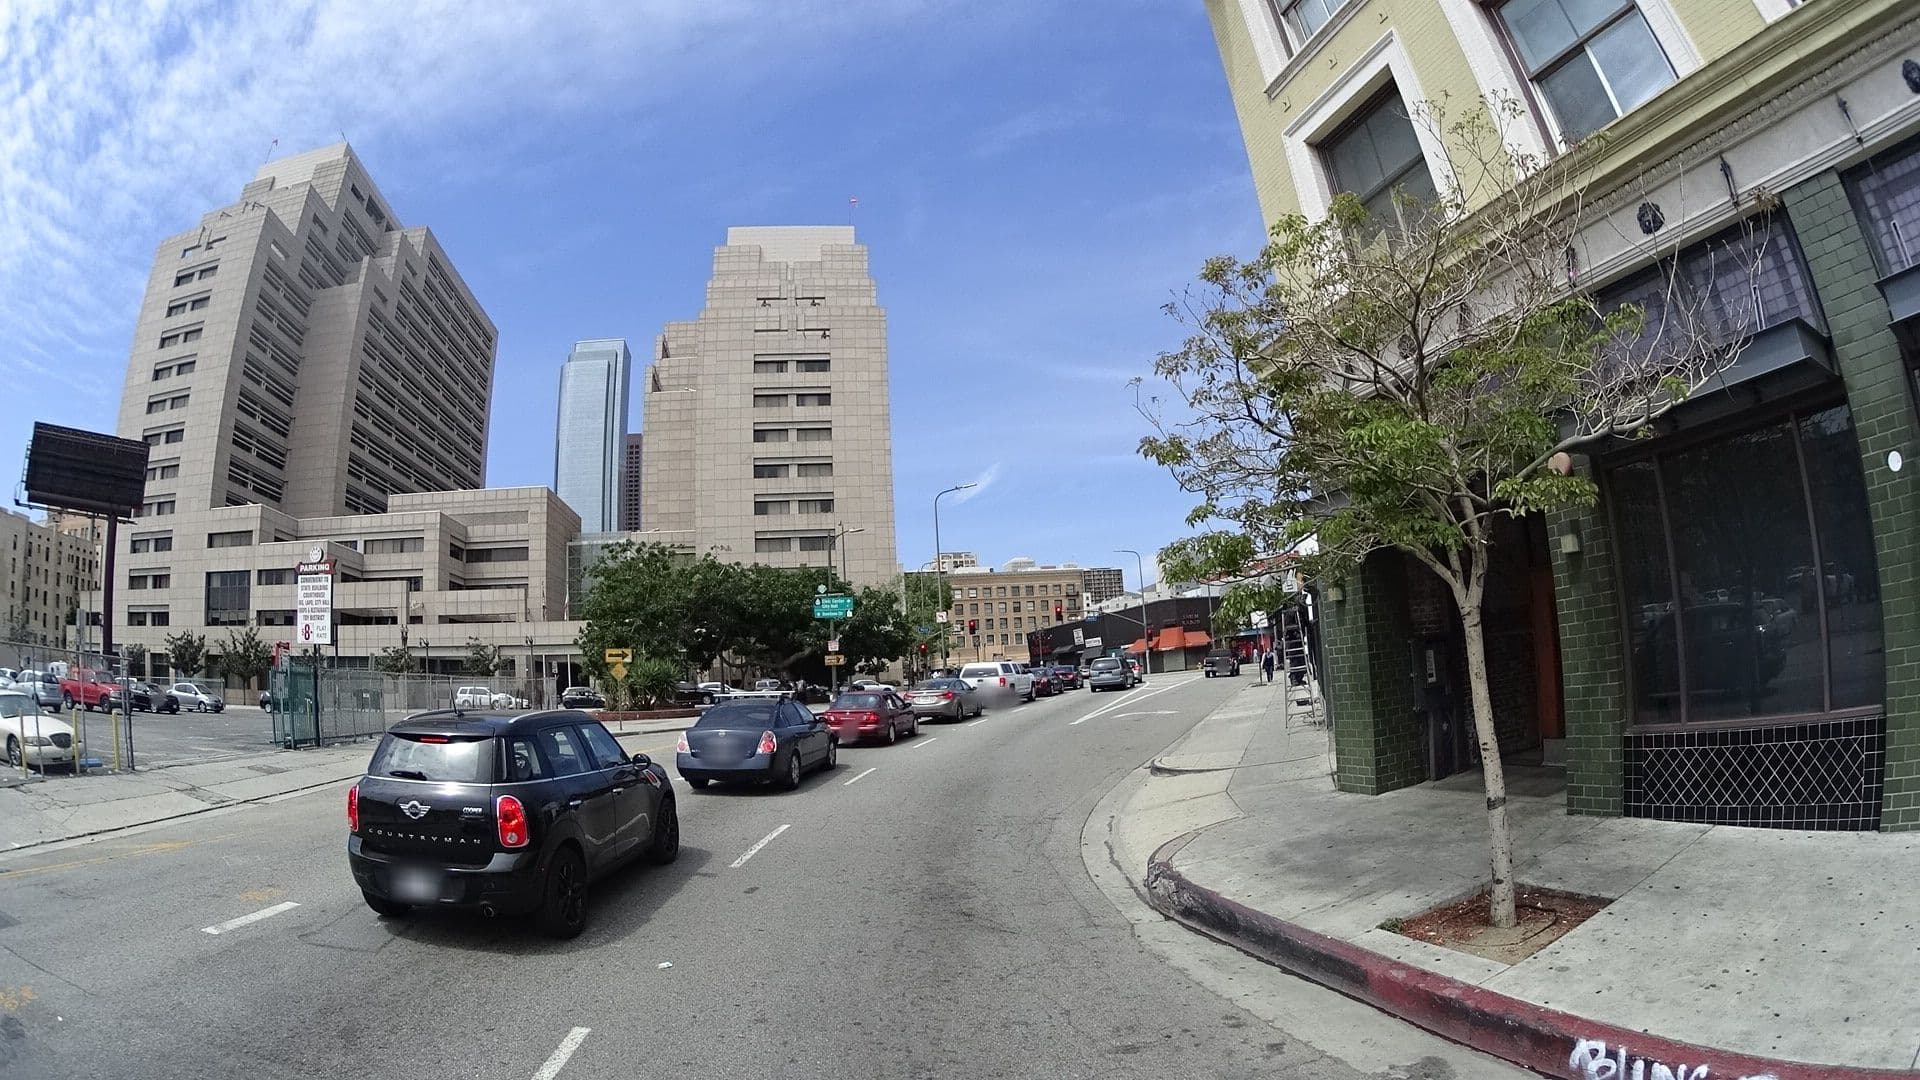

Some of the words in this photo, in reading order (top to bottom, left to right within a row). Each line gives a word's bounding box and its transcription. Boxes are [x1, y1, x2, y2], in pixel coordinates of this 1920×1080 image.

[299, 564, 330, 572] PARKING
[300, 576, 323, 584] CONVENIENT
[368, 827, 481, 845] COUNTRYMAN
